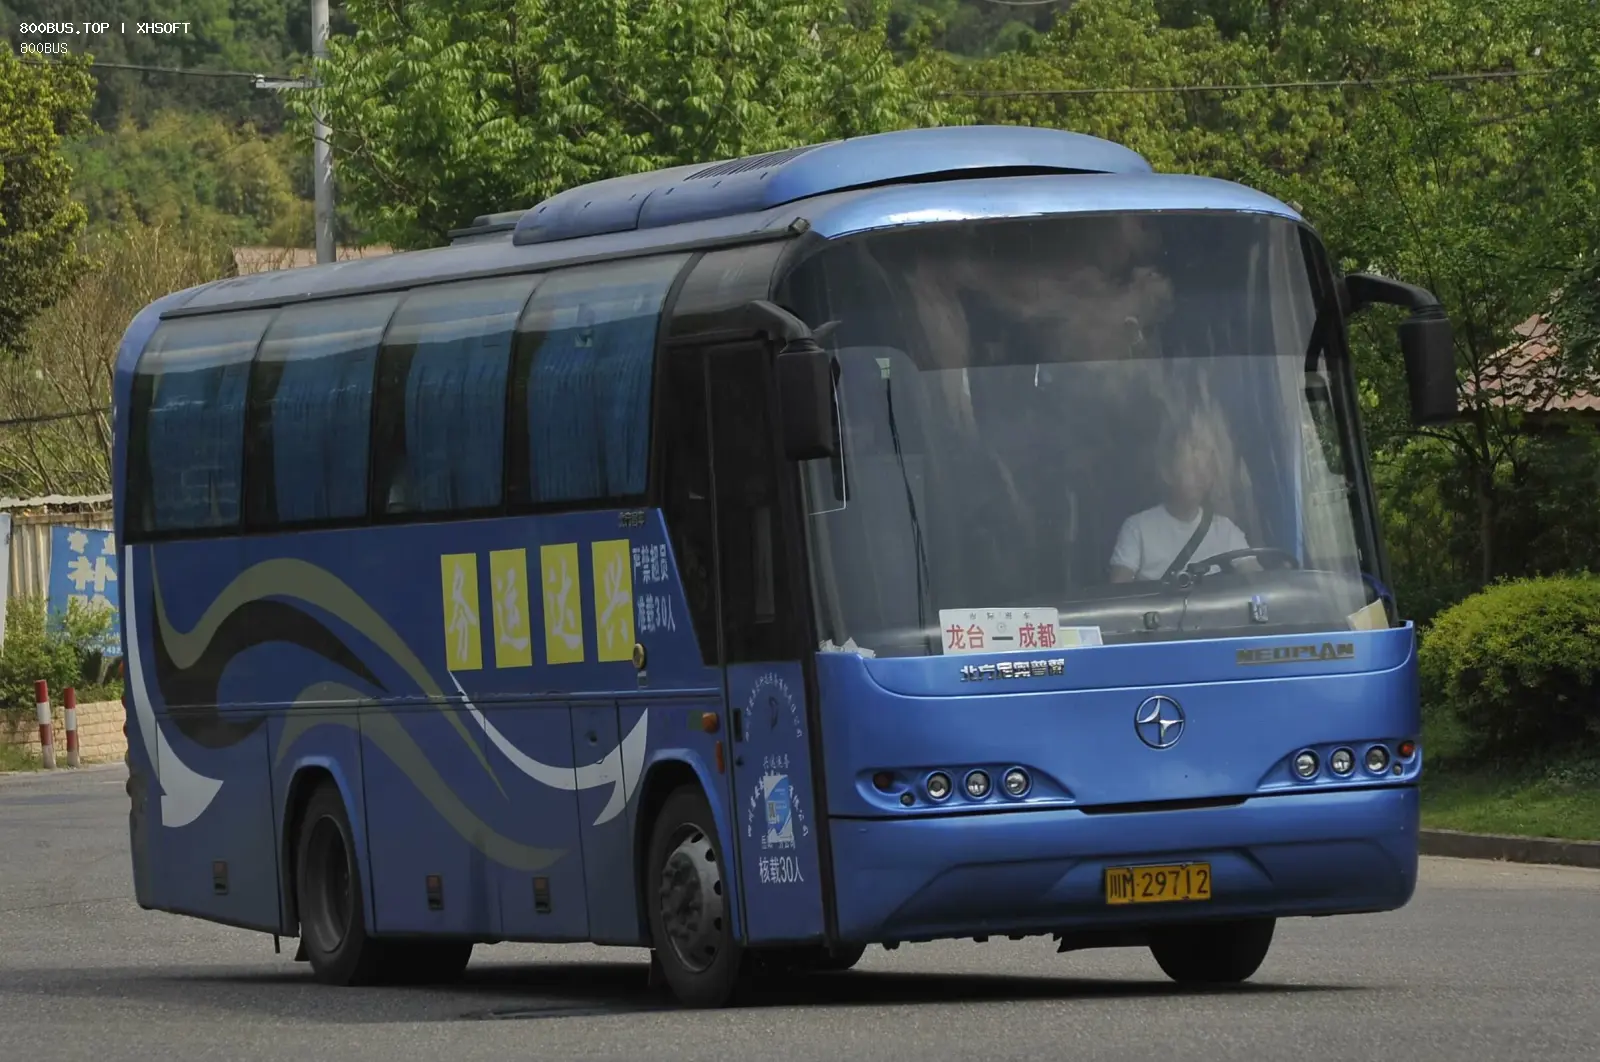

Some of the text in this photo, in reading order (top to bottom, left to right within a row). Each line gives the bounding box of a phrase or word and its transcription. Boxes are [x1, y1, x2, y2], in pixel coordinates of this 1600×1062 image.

[631, 543, 669, 585] 严禁超员
[1236, 643, 1354, 666] NEOPLAN
[758, 856, 804, 884] 核载30人
